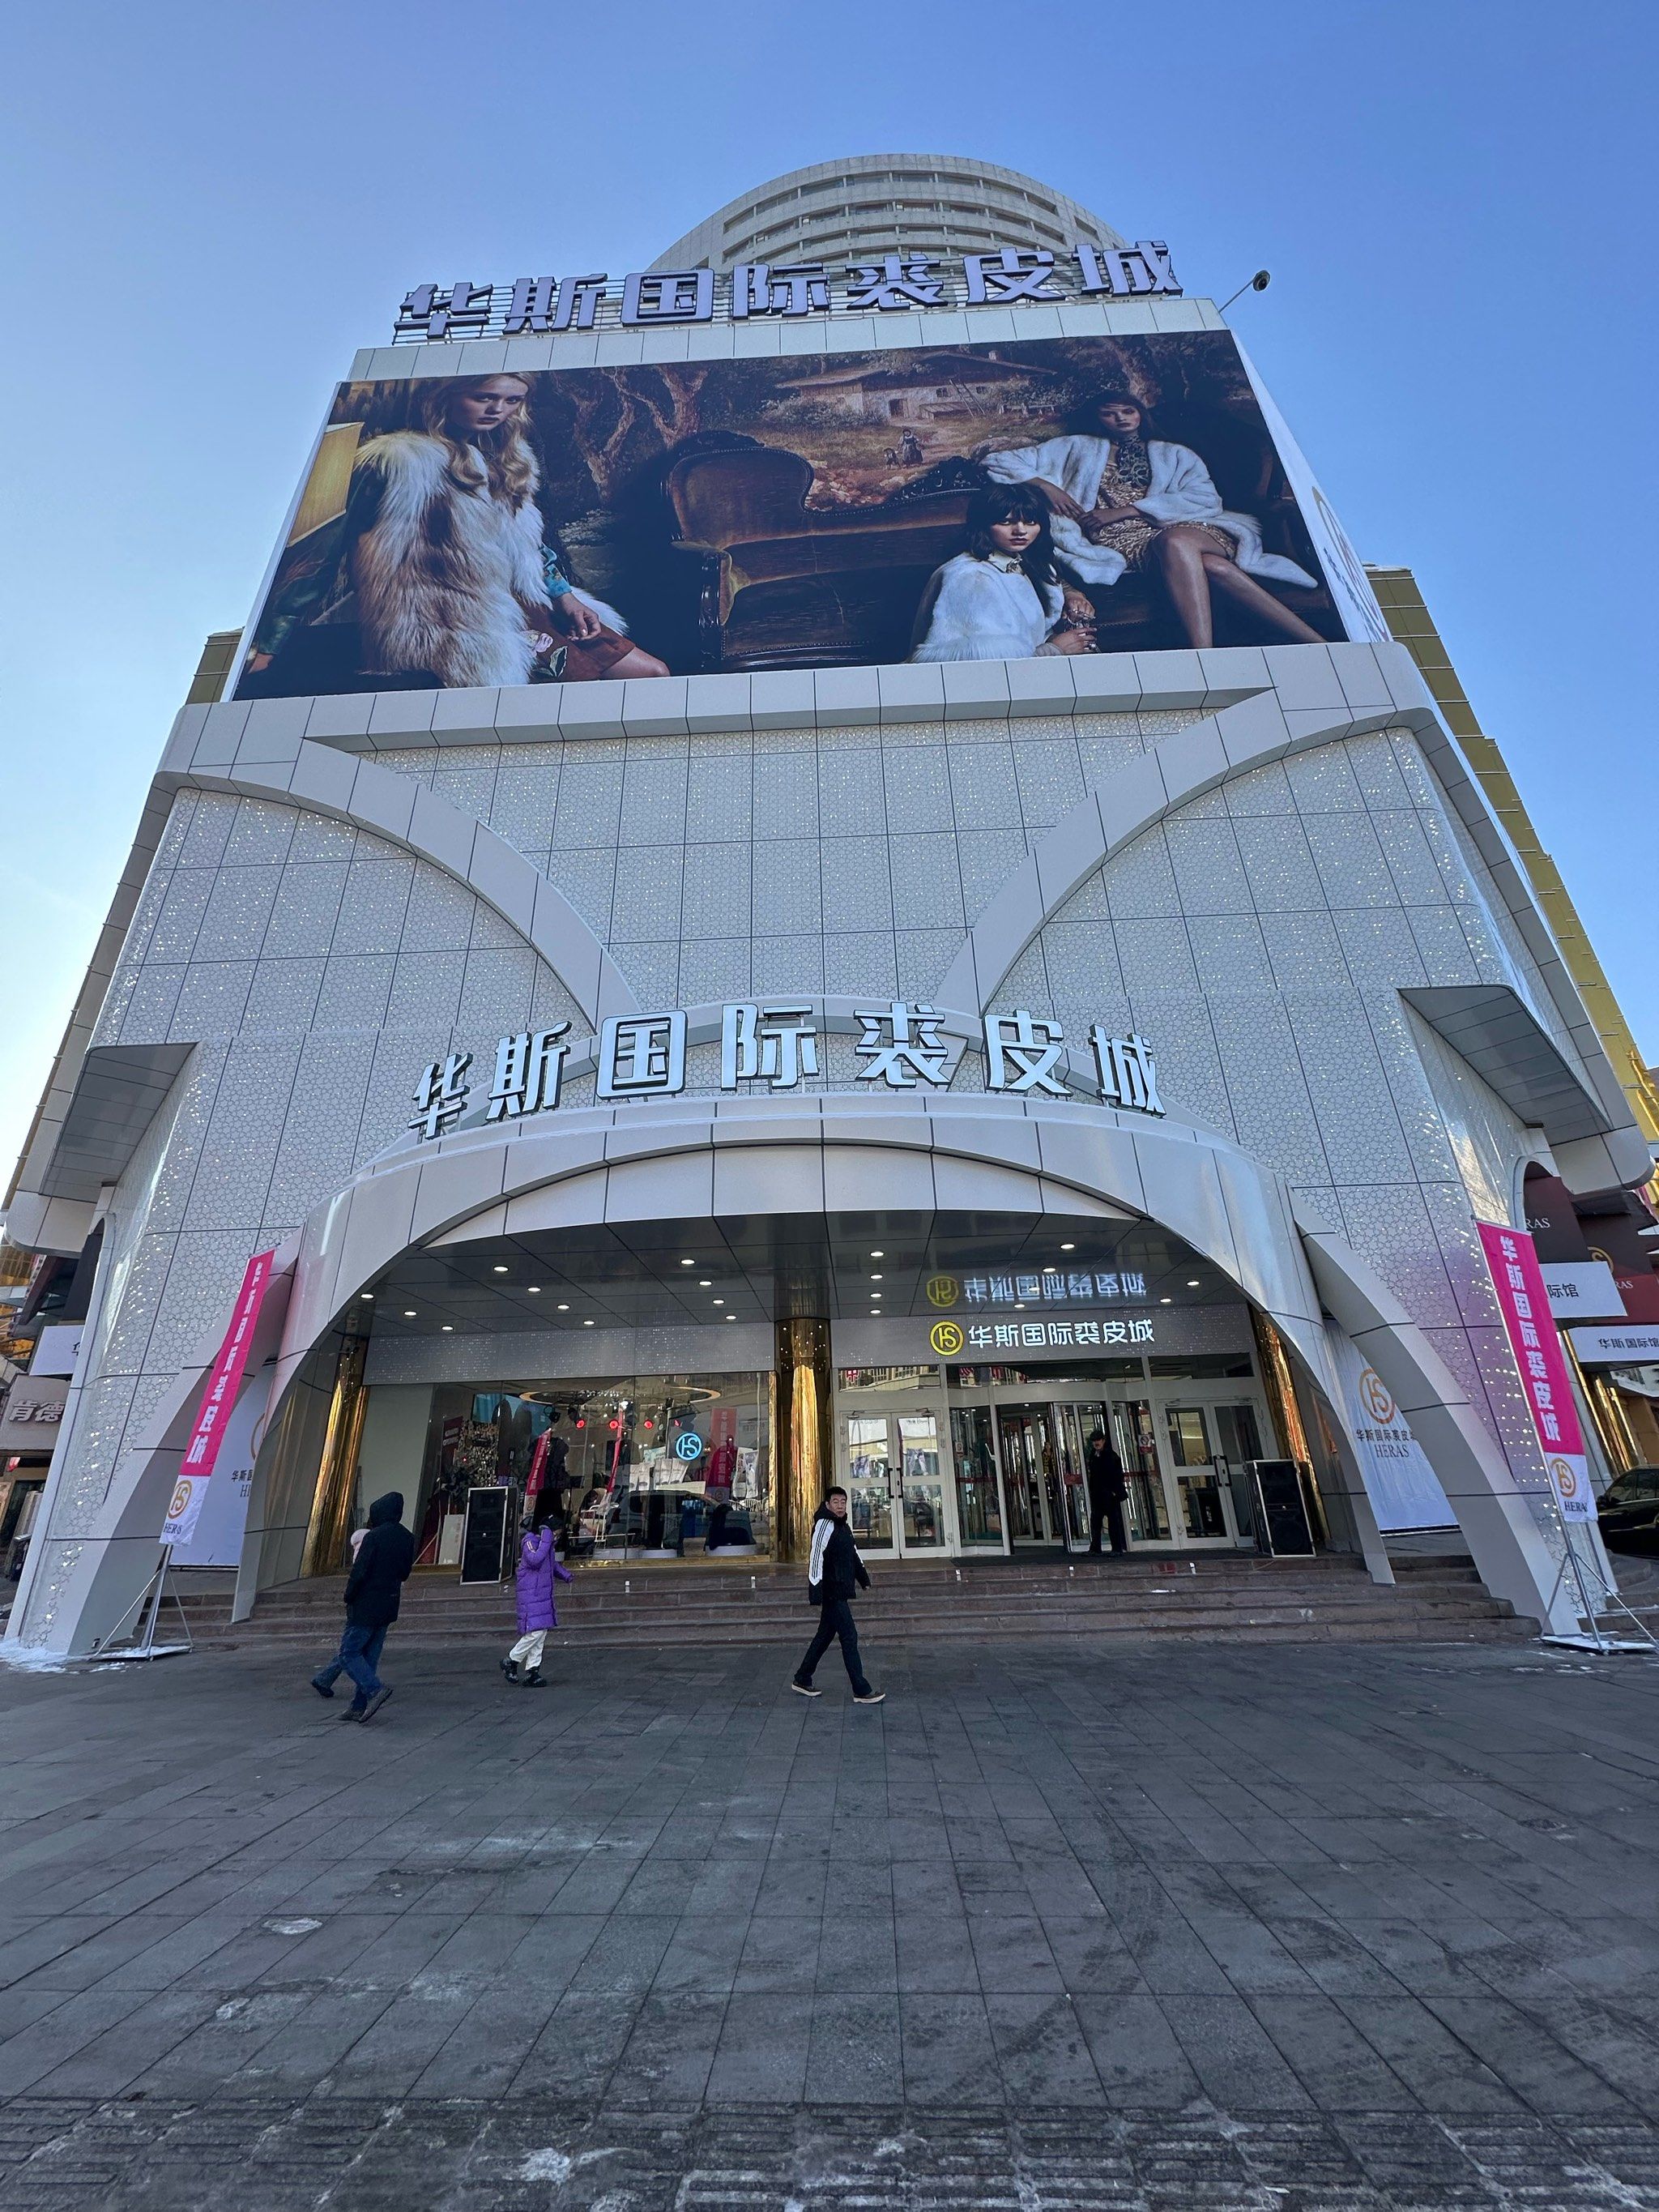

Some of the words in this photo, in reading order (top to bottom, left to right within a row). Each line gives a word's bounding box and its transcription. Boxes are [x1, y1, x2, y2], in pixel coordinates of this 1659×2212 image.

[399, 241, 1183, 338] 华斯国际裘皮城
[407, 1001, 1166, 1140] 华斯国际裘皮城
[1546, 1283, 1579, 1298] 际馆
[967, 1318, 1156, 1349] 华斯国际裘皮城
[1500, 1235, 1561, 1442] 华斯国际裘皮城
[1598, 1337, 1659, 1349] 华斯国际馆
[1375, 1444, 1410, 1458] HERAS
